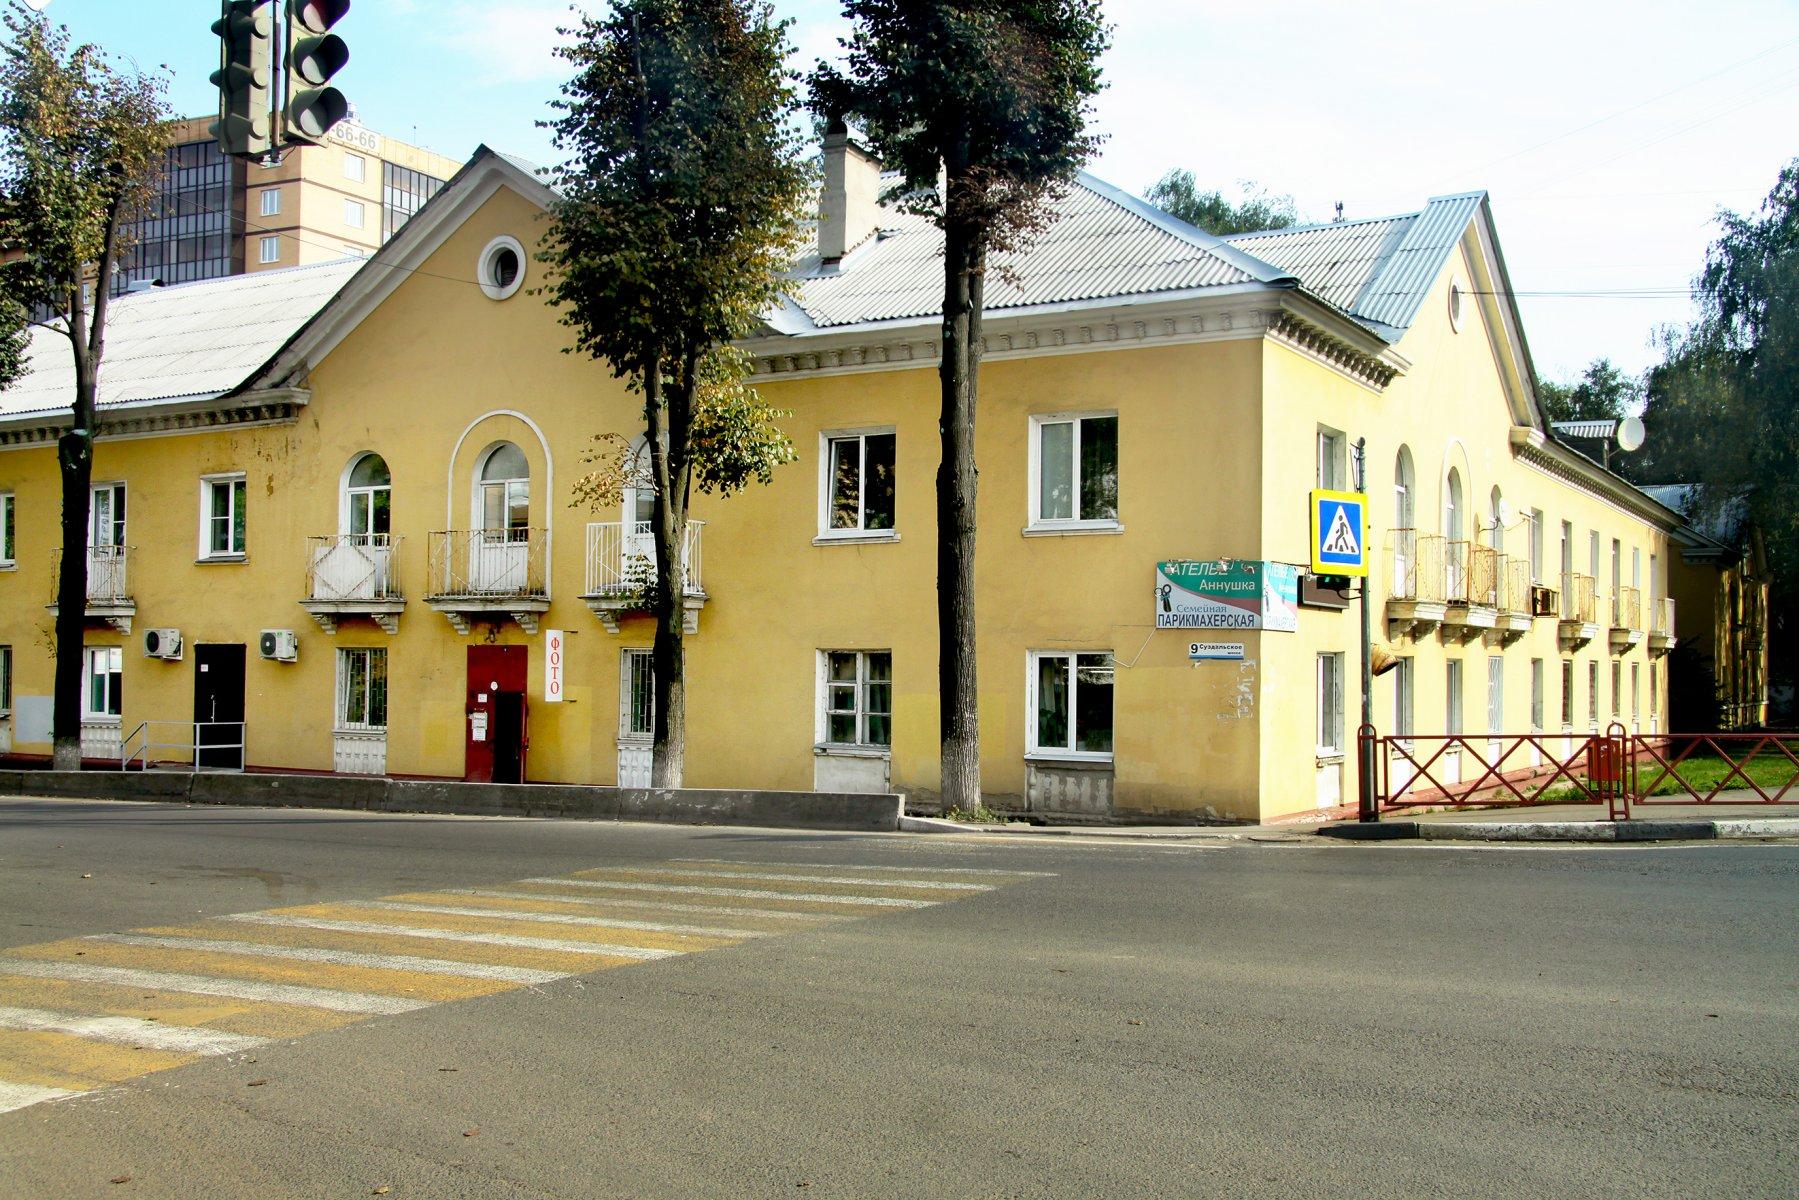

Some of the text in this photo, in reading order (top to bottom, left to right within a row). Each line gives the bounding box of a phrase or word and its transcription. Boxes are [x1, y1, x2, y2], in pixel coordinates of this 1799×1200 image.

[1199, 579, 1255, 592] Аннушка
[1176, 604, 1227, 613] Семейная
[1158, 614, 1255, 627] ПАРИКМАХЕРСКАЯ
[1190, 643, 1198, 654] 9
[550, 637, 560, 694] ФОТО
